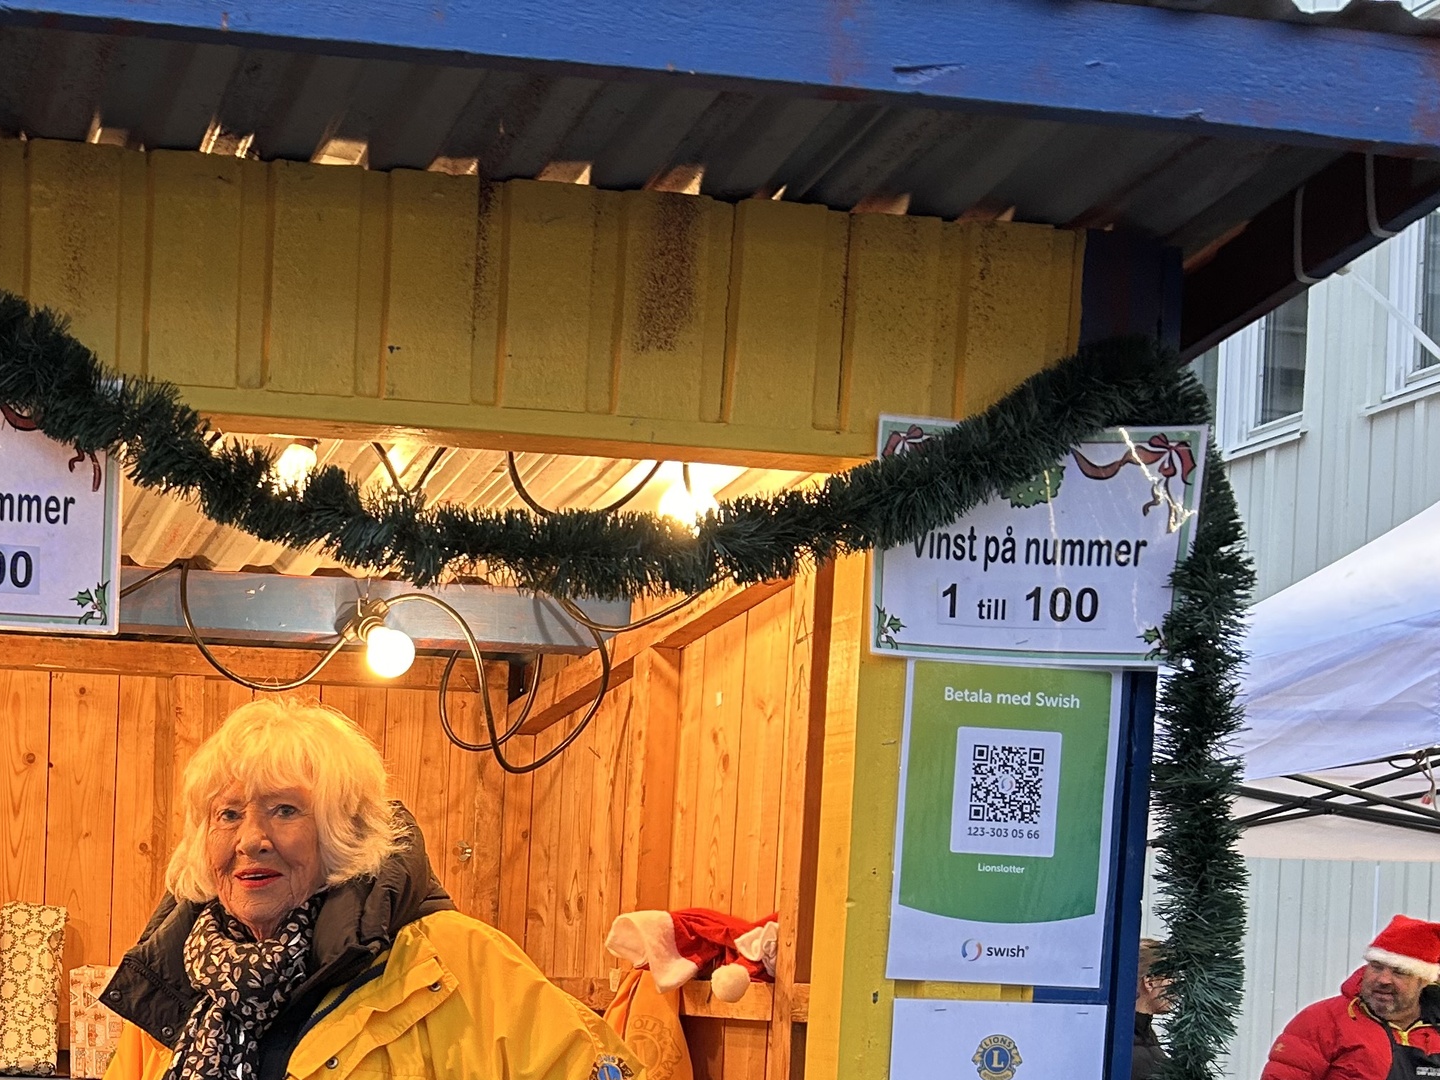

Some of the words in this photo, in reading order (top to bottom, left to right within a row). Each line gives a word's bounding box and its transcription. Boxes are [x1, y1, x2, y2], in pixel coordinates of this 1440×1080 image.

[913, 525, 978, 562] Vinst
[983, 525, 1016, 572] på
[1024, 536, 1148, 568] nummer
[941, 583, 958, 619] 1
[977, 598, 1007, 621] till
[1025, 585, 1100, 623] 100
[943, 686, 993, 704] Betala
[996, 689, 1031, 706] med
[1035, 692, 1081, 709] Swish
[966, 826, 1009, 839] 123-303
[1011, 828, 1025, 840] 05
[1026, 828, 1040, 841] 66
[977, 862, 1026, 875] Lionslotter
[983, 1036, 1013, 1048] LIONS
[991, 1050, 1004, 1068] L
